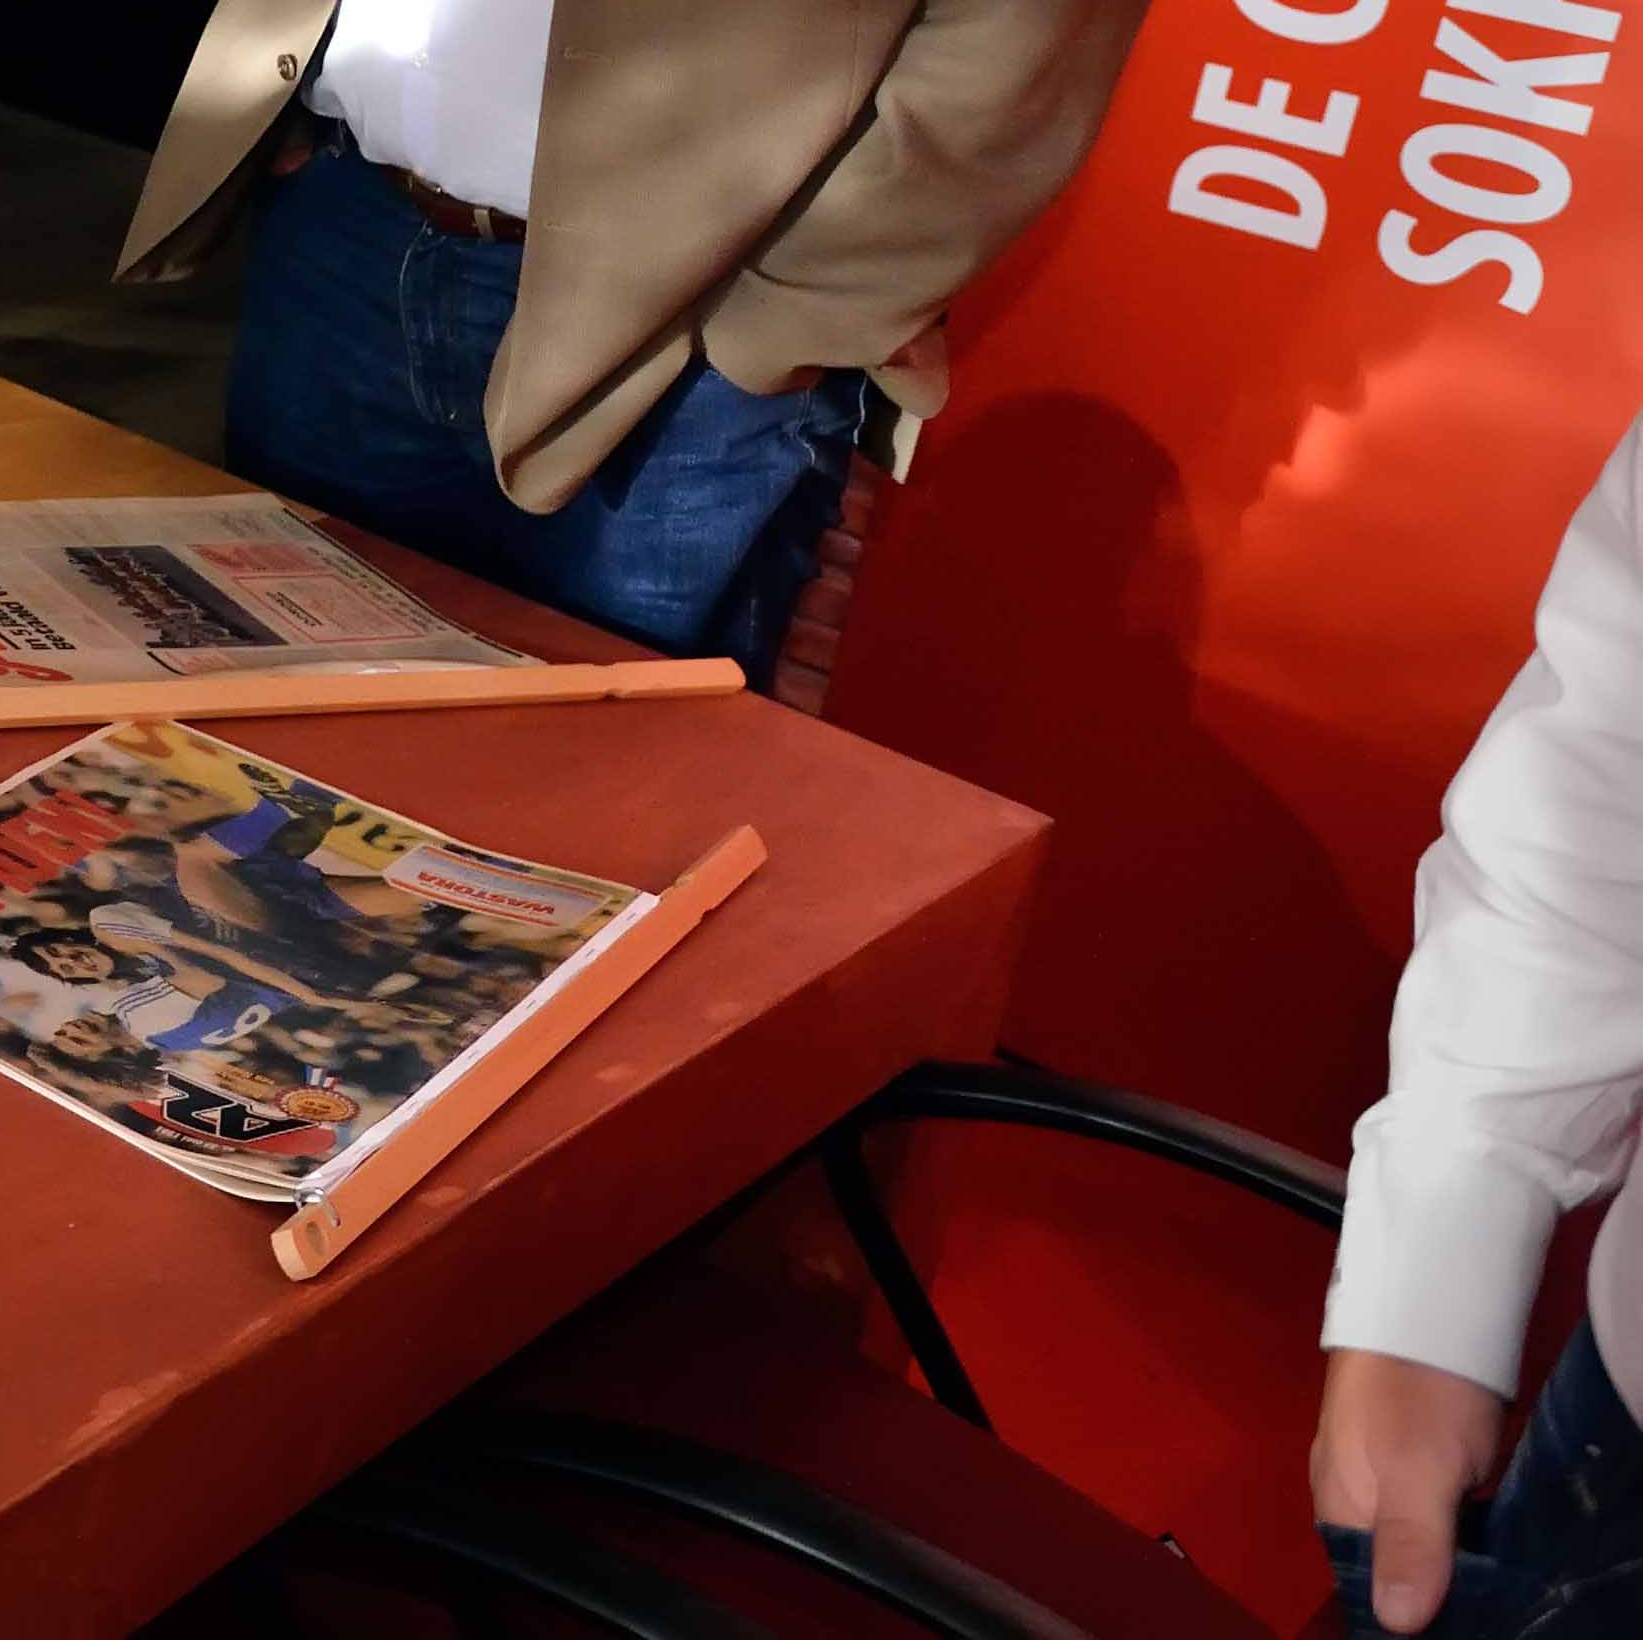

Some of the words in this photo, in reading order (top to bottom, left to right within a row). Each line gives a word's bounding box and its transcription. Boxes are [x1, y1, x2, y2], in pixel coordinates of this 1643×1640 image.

[1167, 72, 1359, 255] DE
[2, 601, 77, 651] Betaald
[417, 872, 555, 915] WASTORA
[159, 1067, 320, 1143] AZ
